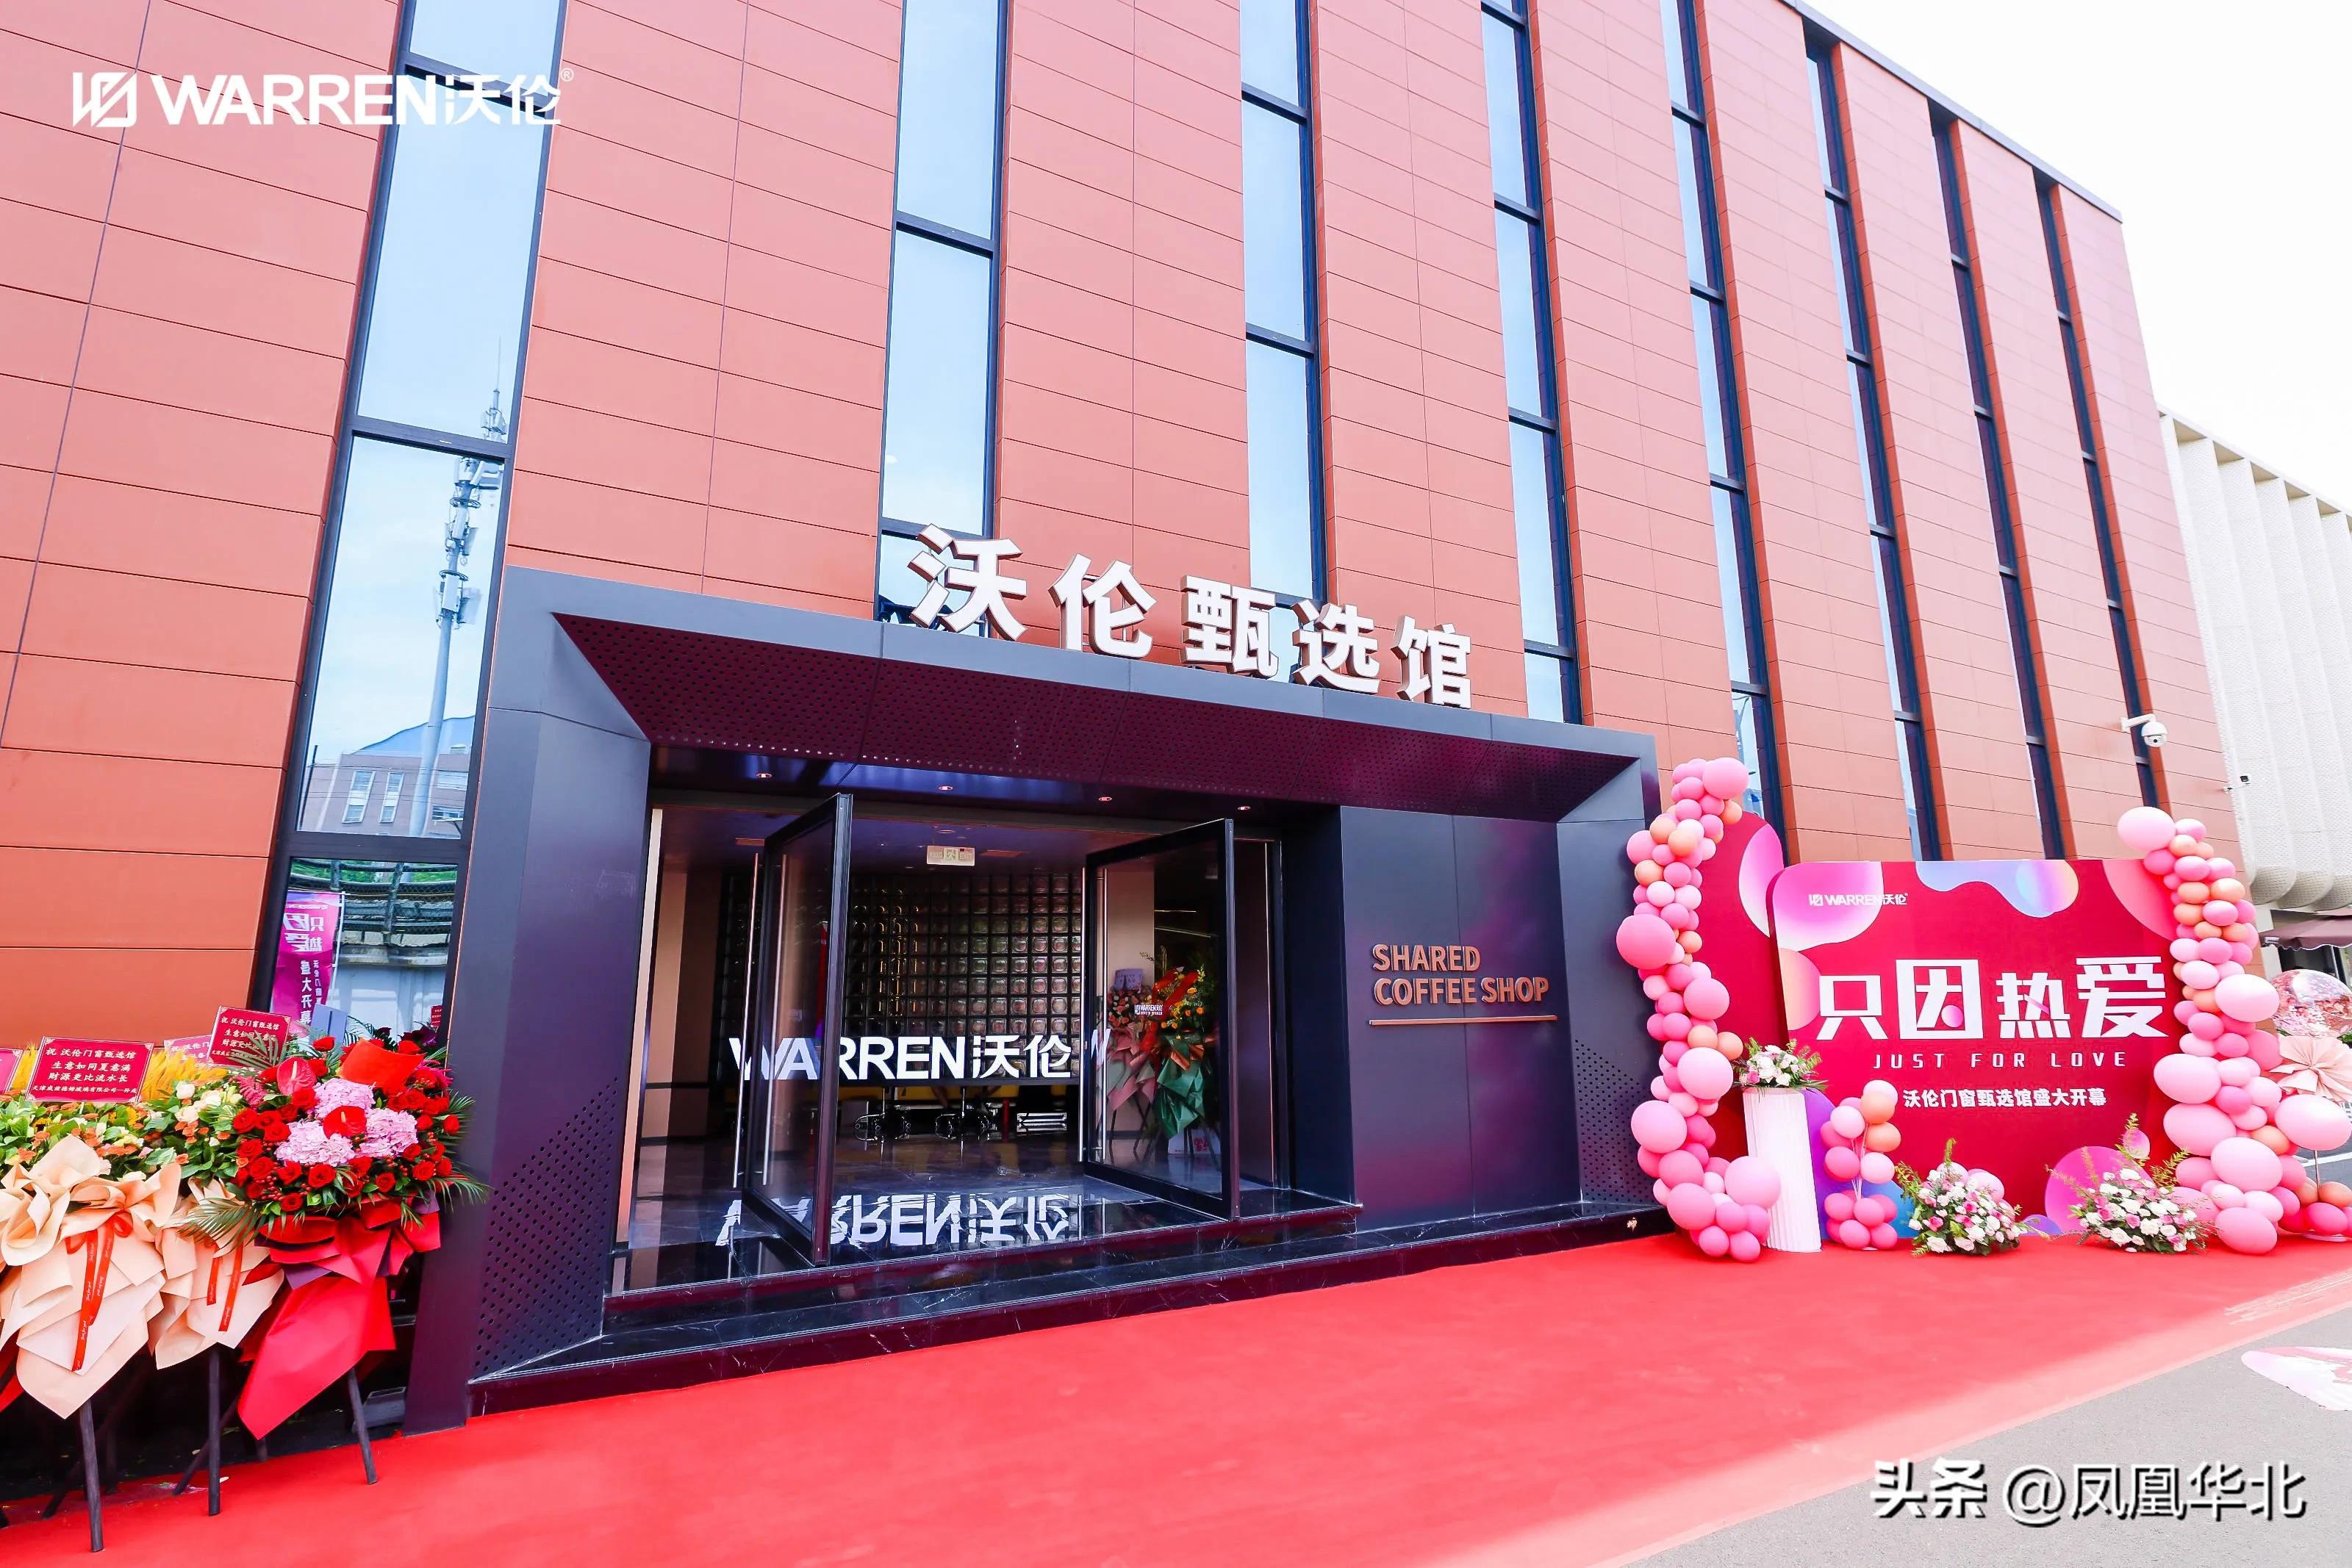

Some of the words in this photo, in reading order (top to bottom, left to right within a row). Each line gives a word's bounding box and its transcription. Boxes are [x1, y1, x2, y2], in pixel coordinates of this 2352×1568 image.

[908, 523, 1471, 709] 沃伦甄选馆
[1372, 944, 1481, 972] SHARED
[1374, 977, 1477, 1006] COFFEE
[1481, 977, 1549, 1003] SHOP
[1816, 956, 2170, 1040] 只因热爱
[46, 1047, 57, 1056] 祝
[1873, 1052, 1945, 1069] JUST
[1971, 1052, 2025, 1068] FOR
[2050, 1051, 2126, 1068] LOVE
[1902, 1087, 2107, 1108] 沃伦门窗甄选馆盛大开幕
